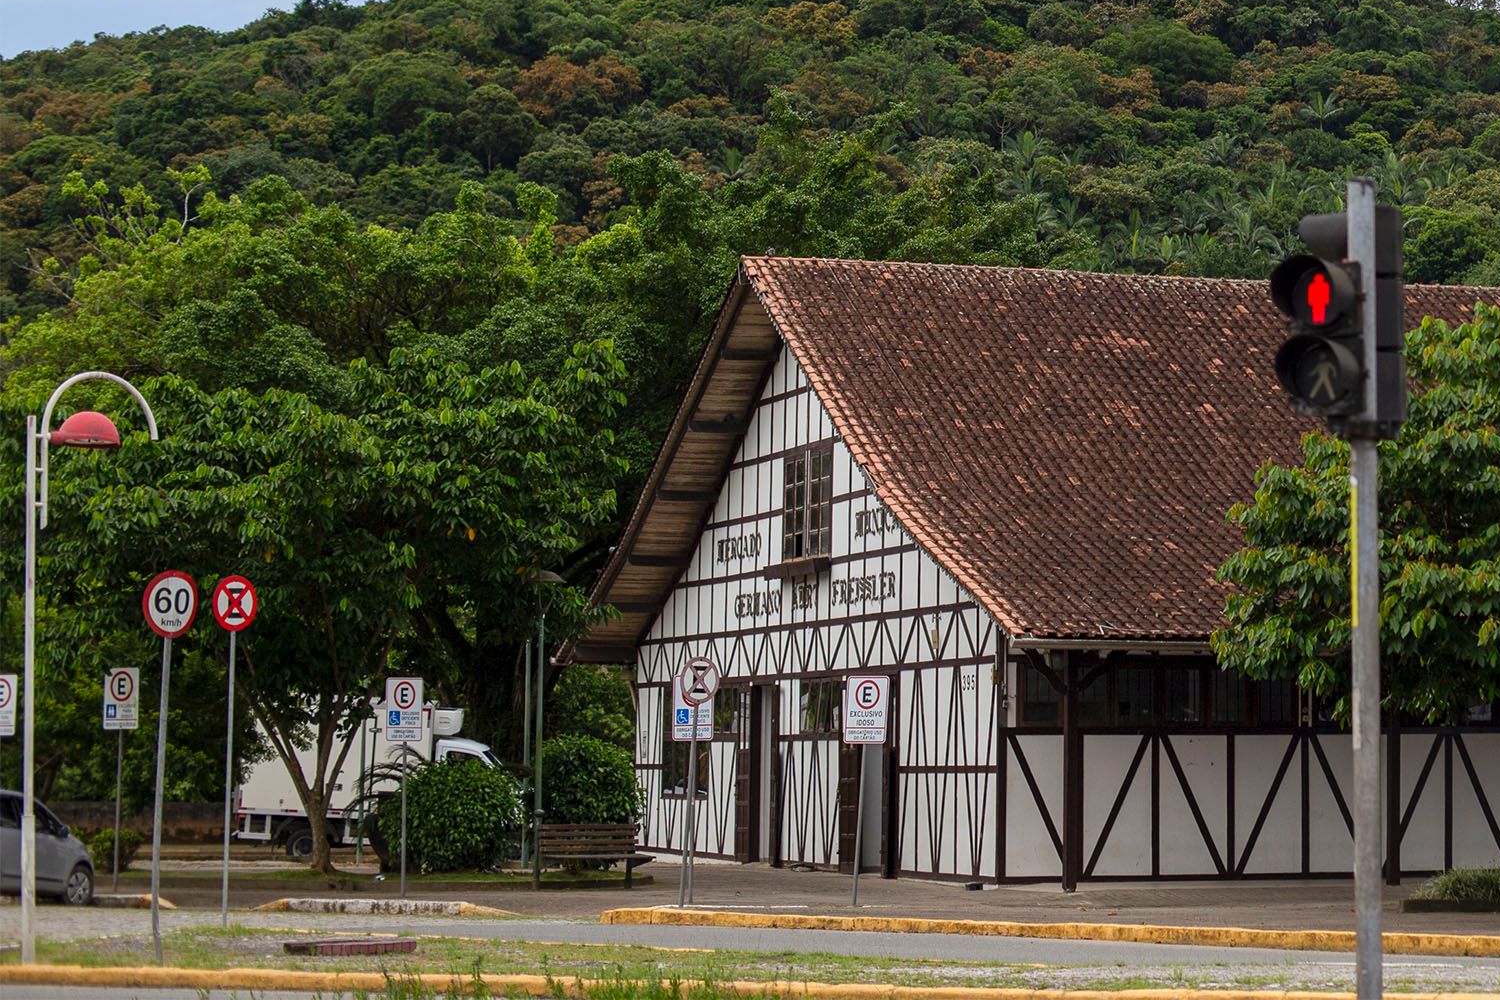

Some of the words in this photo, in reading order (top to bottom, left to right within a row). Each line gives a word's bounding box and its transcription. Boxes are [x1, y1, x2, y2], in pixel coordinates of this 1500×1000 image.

[717, 533, 762, 565] MERCADO
[155, 587, 190, 615] 60
[734, 588, 782, 619] GERMANO
[832, 571, 896, 607] FREISSLER
[161, 618, 182, 628] km/h
[118, 678, 126, 695] E
[963, 674, 976, 691] 395
[401, 688, 408, 703] E
[862, 686, 873, 703] E
[849, 710, 883, 718] EXCLUSIVO
[855, 719, 875, 727] IDOSO
